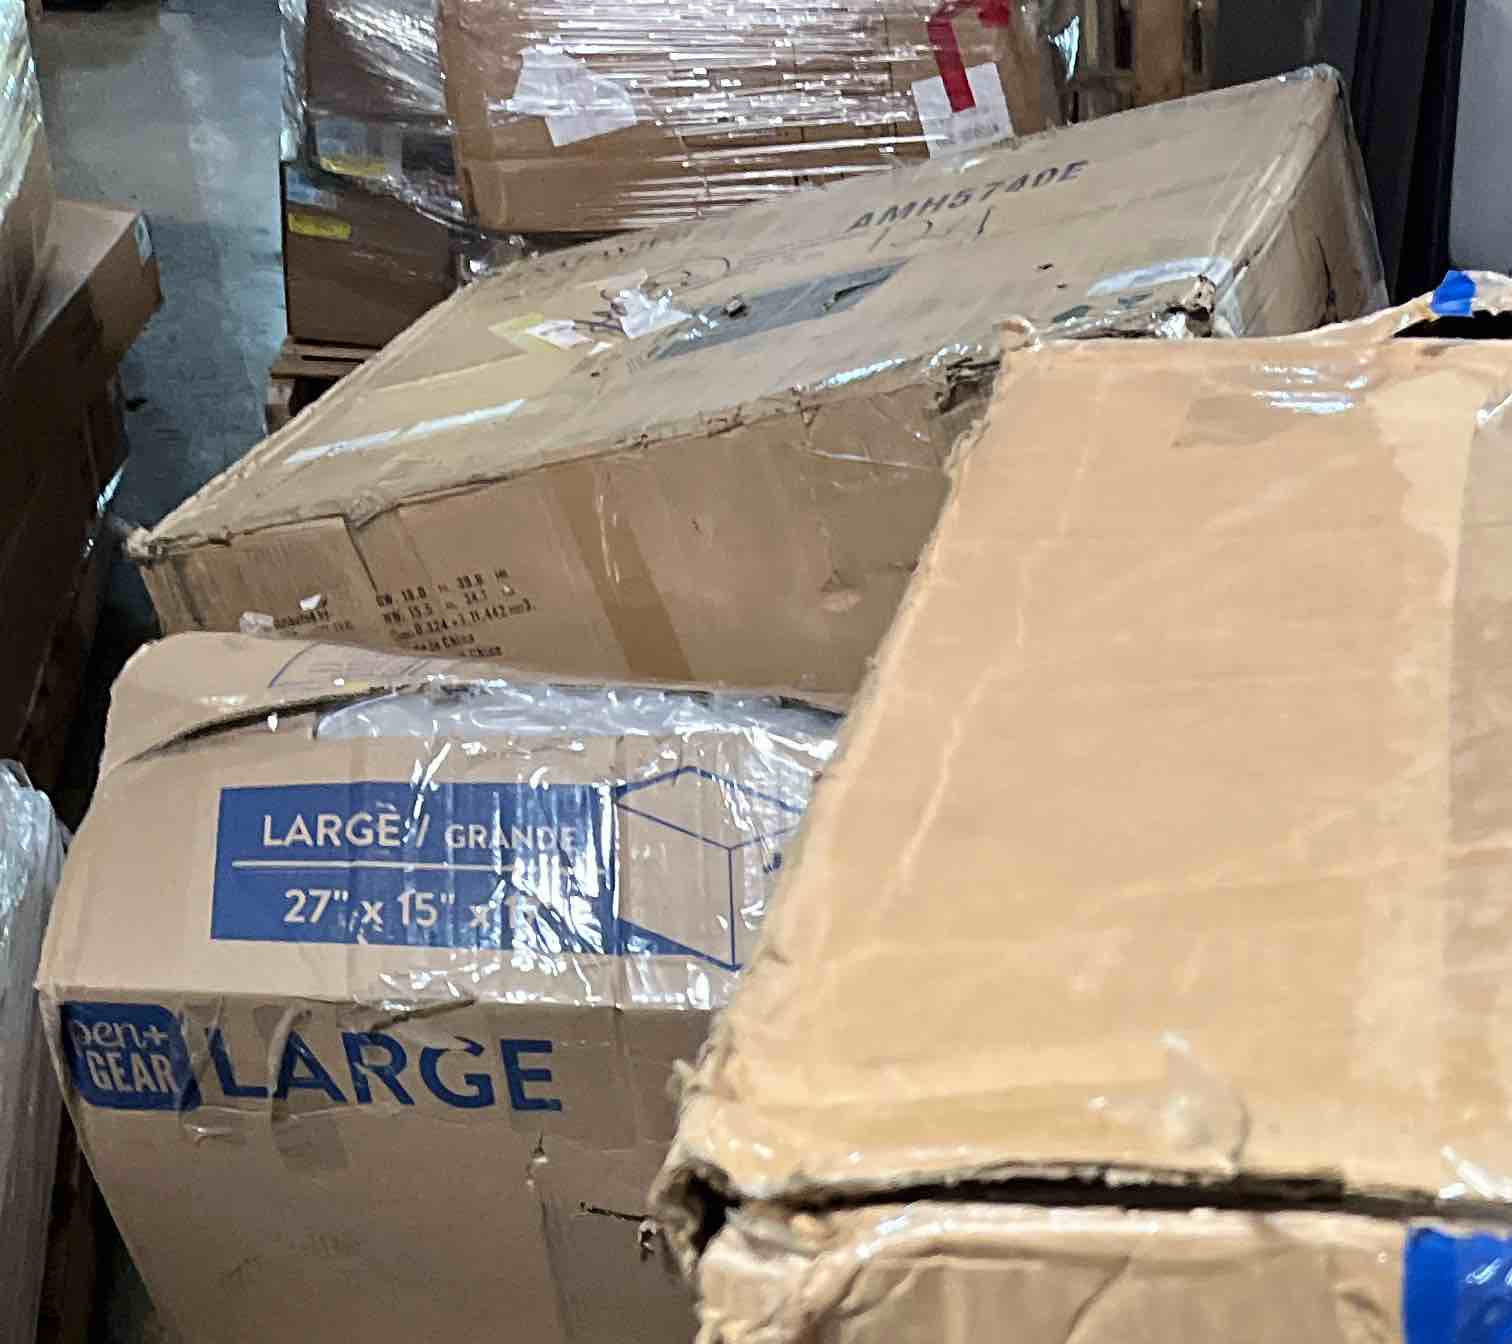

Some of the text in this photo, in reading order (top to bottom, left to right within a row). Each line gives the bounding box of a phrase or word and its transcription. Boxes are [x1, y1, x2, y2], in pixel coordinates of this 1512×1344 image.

[262, 812, 401, 848] LARGE
[444, 823, 578, 850] GRANDE
[283, 888, 349, 924] 27"
[85, 1049, 180, 1095] GEAR
[206, 1028, 562, 1112] LARGE
